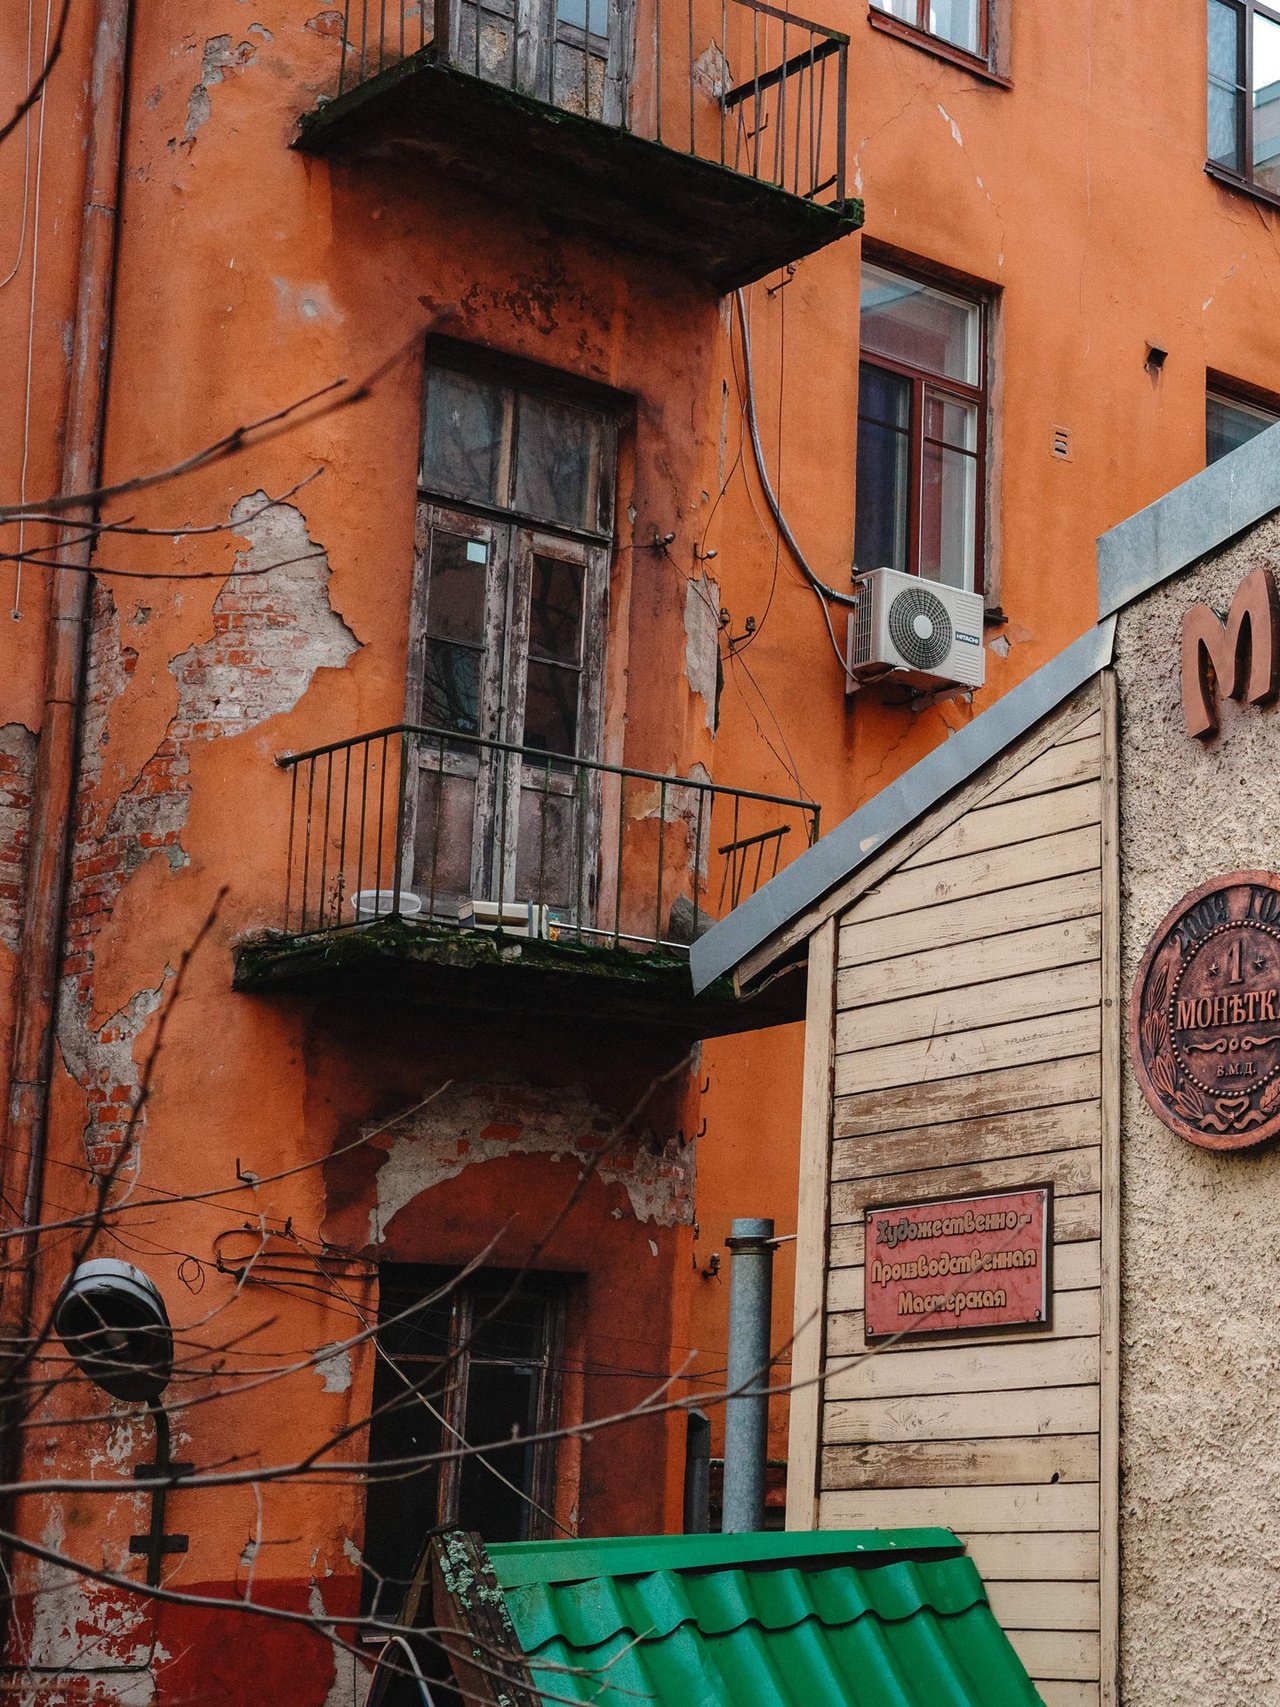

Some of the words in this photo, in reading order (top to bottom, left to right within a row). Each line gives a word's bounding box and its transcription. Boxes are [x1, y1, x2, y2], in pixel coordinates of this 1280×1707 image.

[956, 633, 979, 644] HITACHI
[1168, 890, 1229, 960] 2009
[1228, 939, 1245, 984] 1
[1216, 1061, 1258, 1077] В.М.Д.
[876, 1210, 1032, 1249] Художественно-
[871, 1248, 1037, 1288] Производственная
[897, 1289, 1008, 1317] Мастерская
